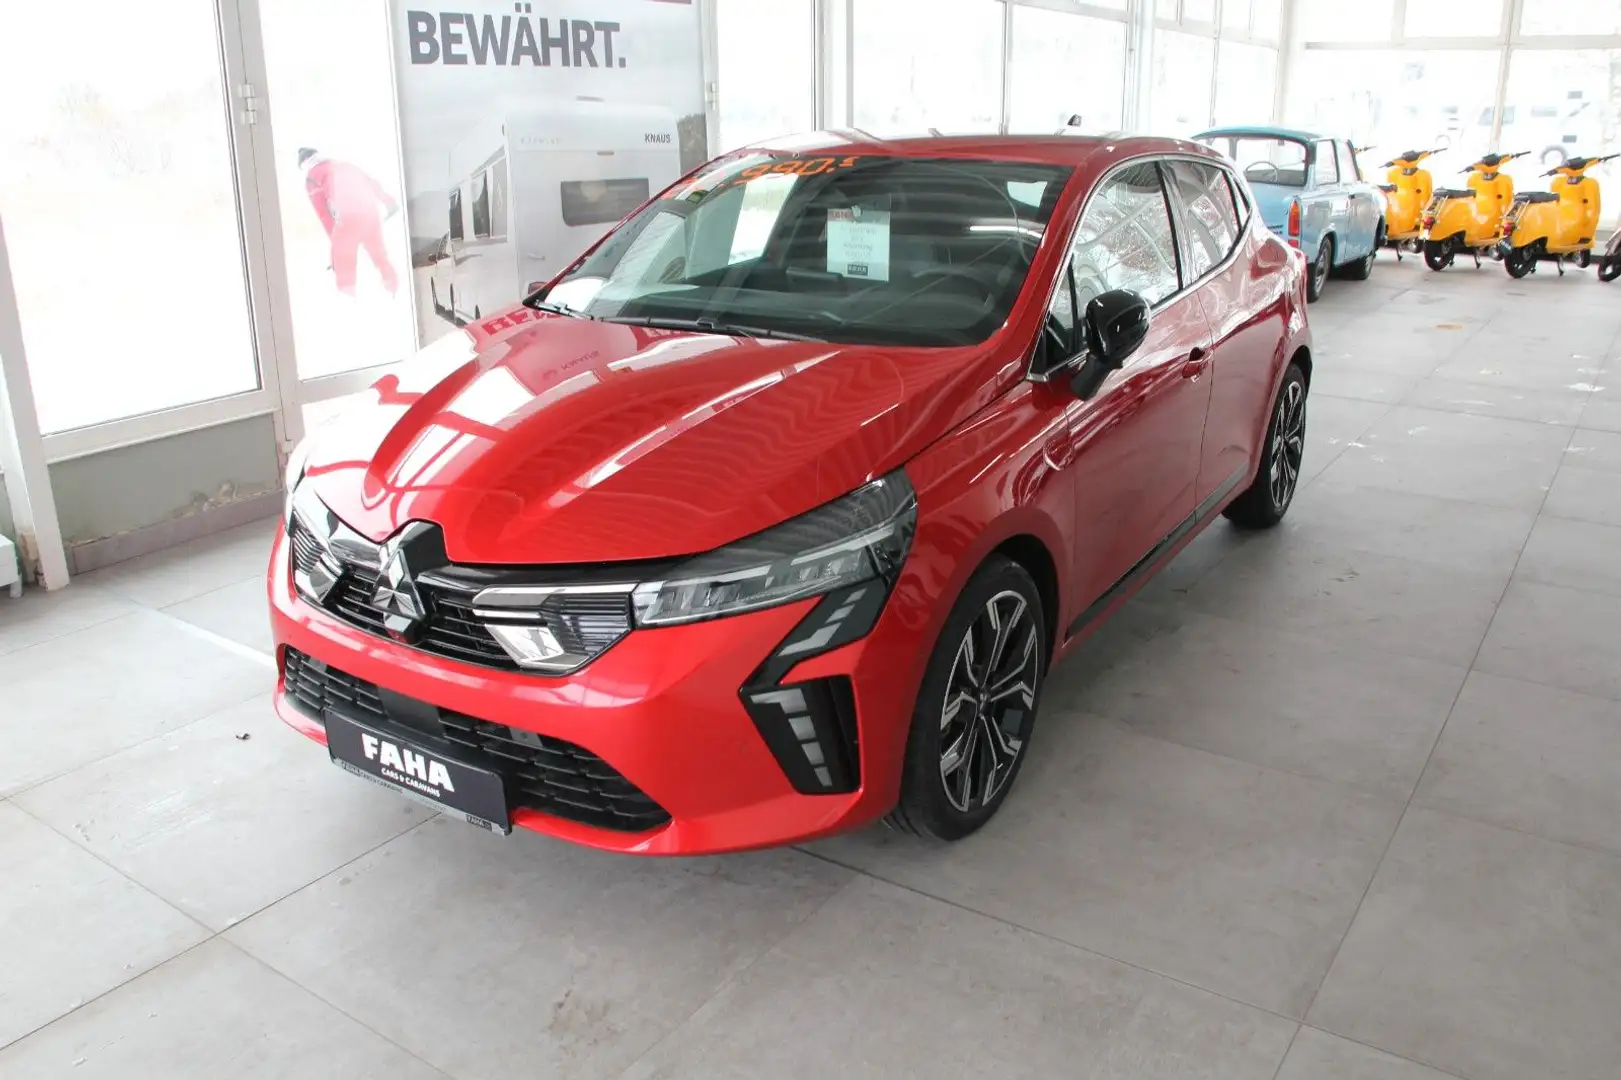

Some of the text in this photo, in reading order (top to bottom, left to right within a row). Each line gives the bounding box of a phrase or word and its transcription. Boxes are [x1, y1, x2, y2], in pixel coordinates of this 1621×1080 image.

[407, 3, 627, 68] BEWÄHRT.
[644, 133, 671, 144] KNAUS
[361, 732, 455, 793] FAHA
[381, 767, 399, 782] CARS
[405, 777, 441, 798] CARAVANS
